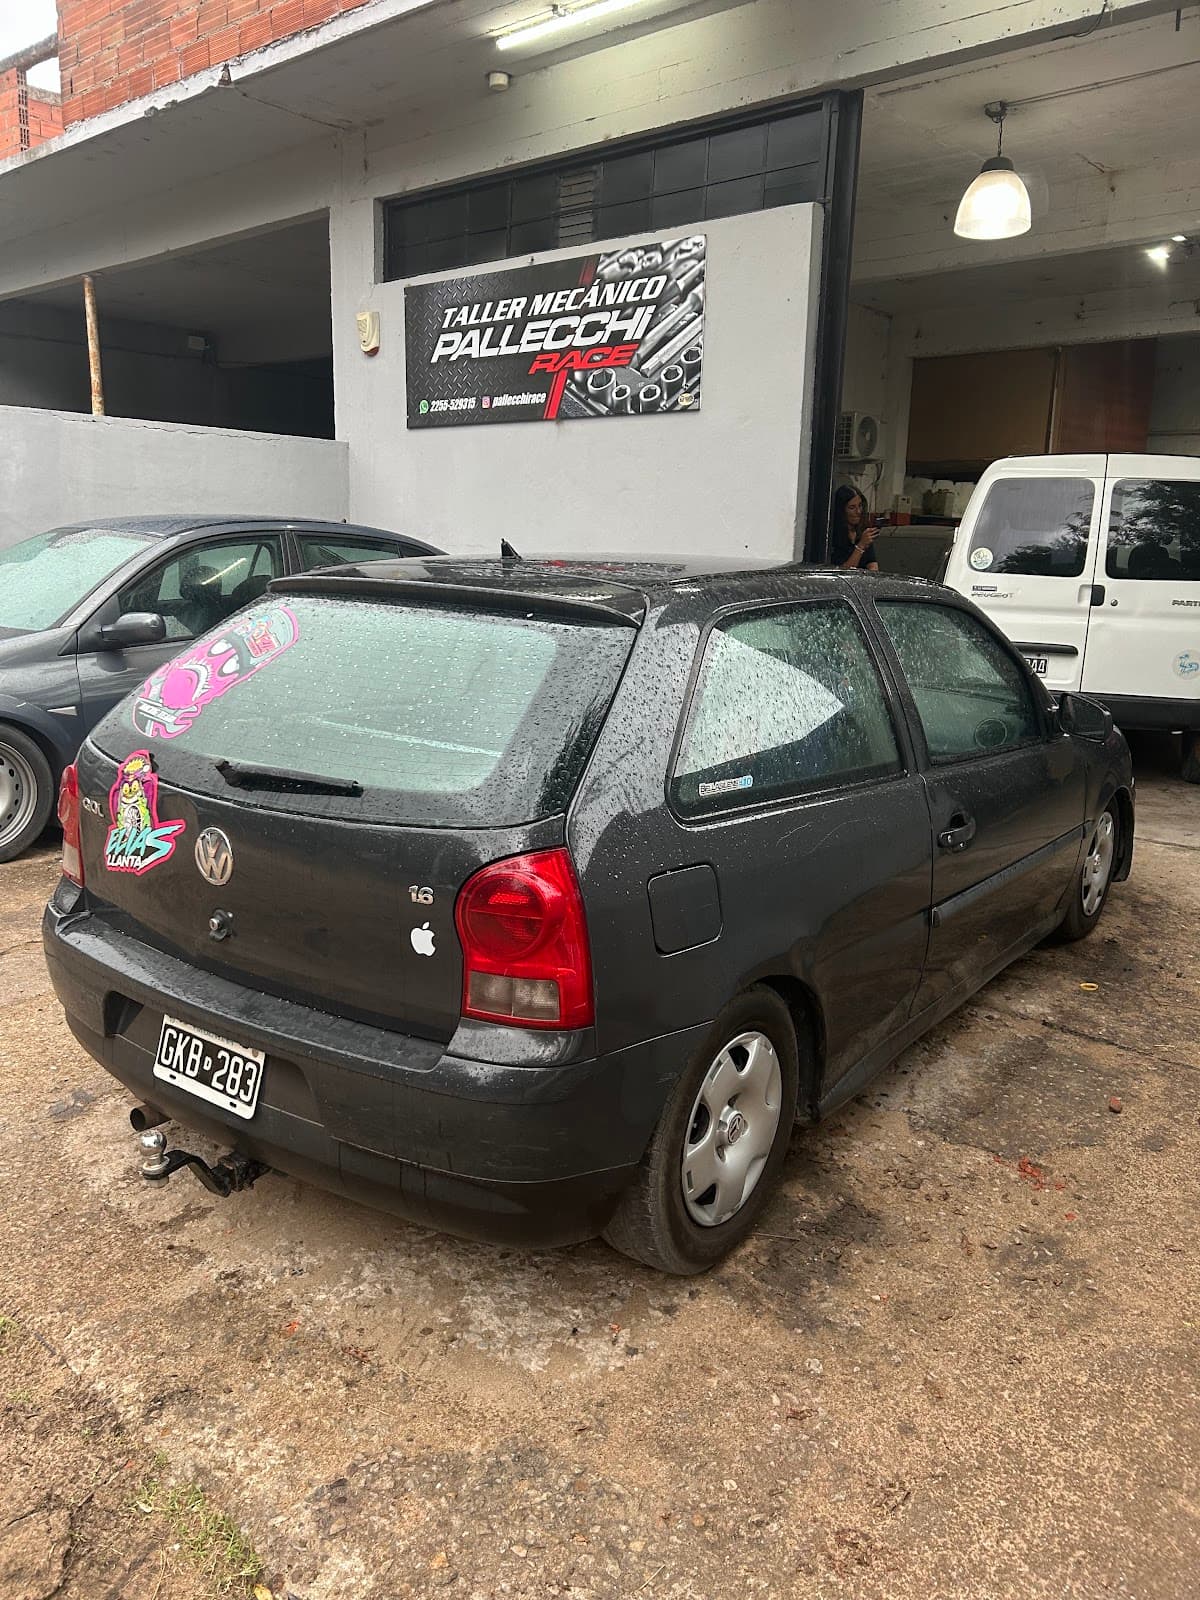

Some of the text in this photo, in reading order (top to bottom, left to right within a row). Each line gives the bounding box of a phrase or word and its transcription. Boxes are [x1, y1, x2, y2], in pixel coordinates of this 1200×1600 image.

[442, 275, 669, 329] TALLER MECÁNICO
[528, 343, 640, 375] RACE
[430, 396, 476, 412] 2255-529315
[492, 392, 547, 408] pallecchirace
[1026, 659, 1046, 673] 44
[82, 796, 105, 818] GOL
[106, 824, 183, 871] ELIAS
[161, 1028, 203, 1078] GKB
[211, 1049, 258, 1103] 283
